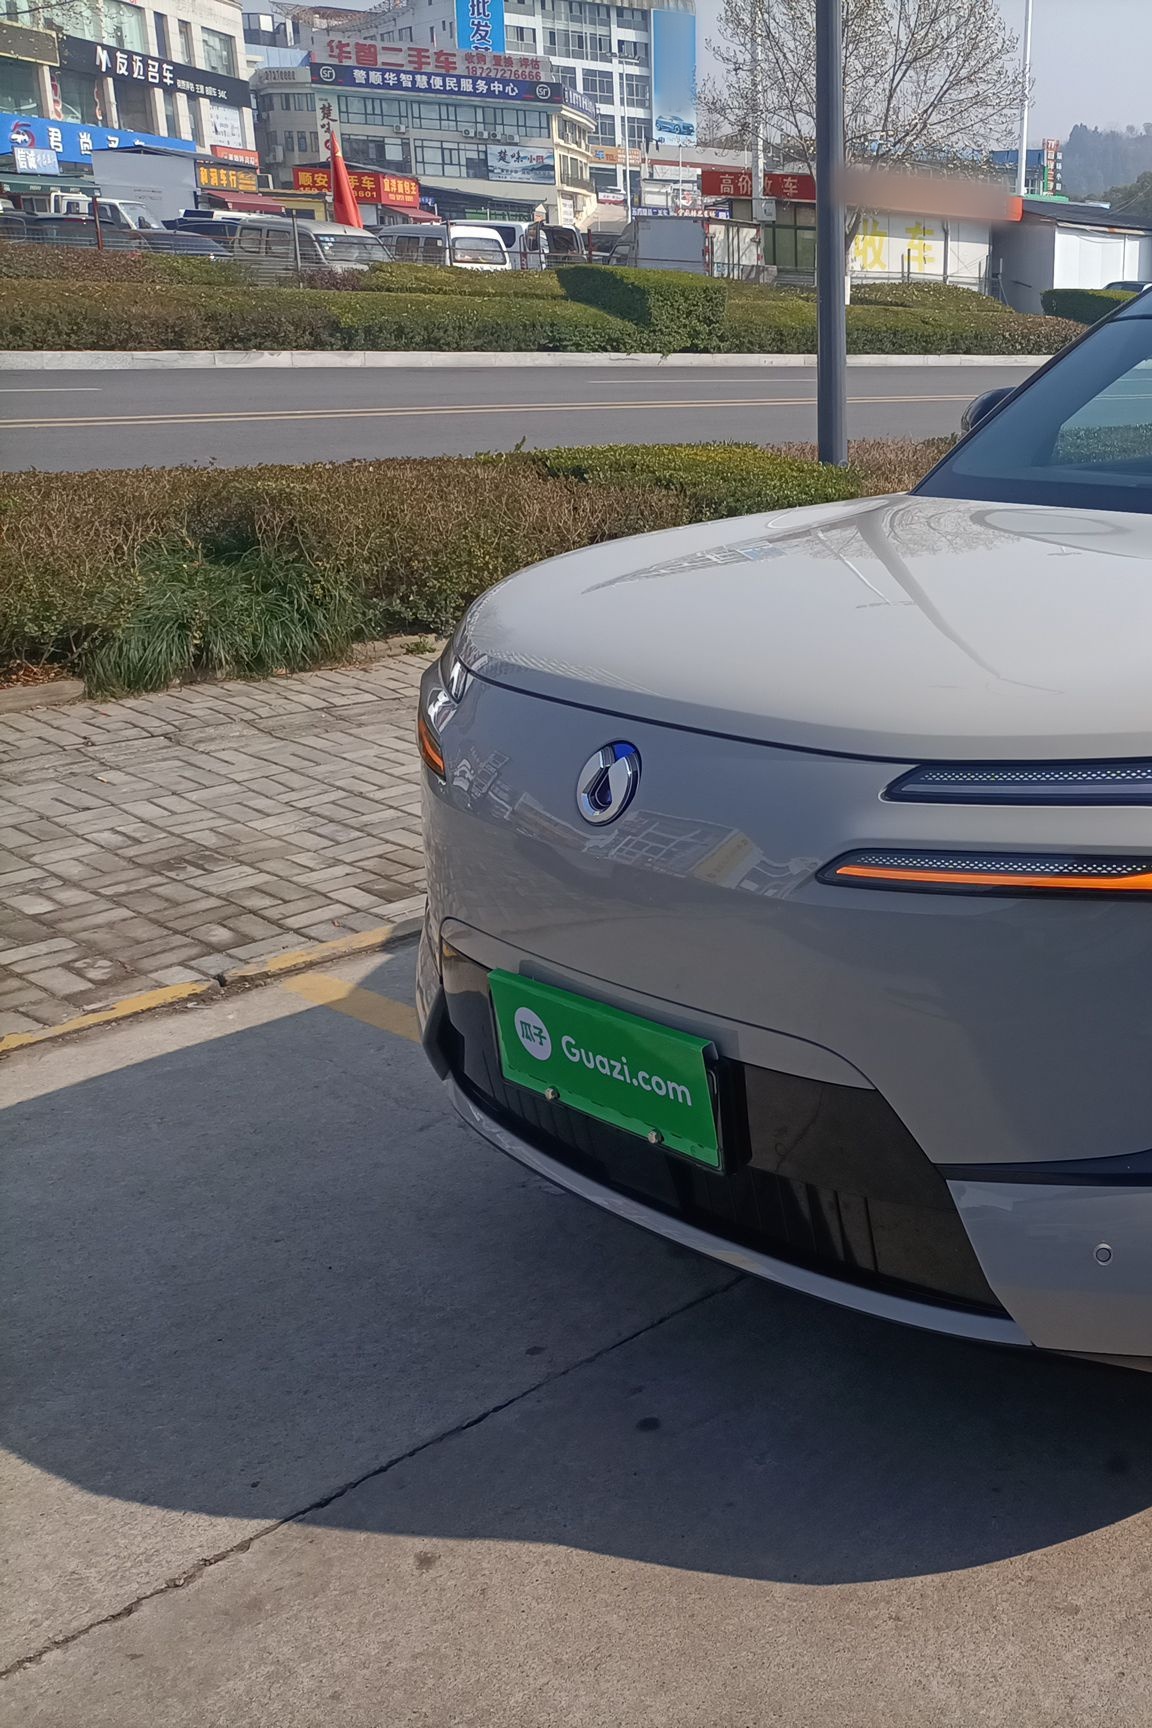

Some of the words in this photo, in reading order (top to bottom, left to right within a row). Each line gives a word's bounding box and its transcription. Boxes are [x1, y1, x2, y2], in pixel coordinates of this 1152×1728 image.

[115, 51, 174, 86] 友迈名车
[326, 39, 457, 73] 华智二手车
[464, 52, 486, 65] 收购
[519, 57, 540, 70] 评估
[352, 69, 519, 96] 警顺华智慧便民服务中心
[465, 66, 542, 81] 18727276666
[298, 171, 376, 190] 顺安手车
[520, 1020, 547, 1046] 瓜子
[562, 1035, 692, 1106] Guazi.com
